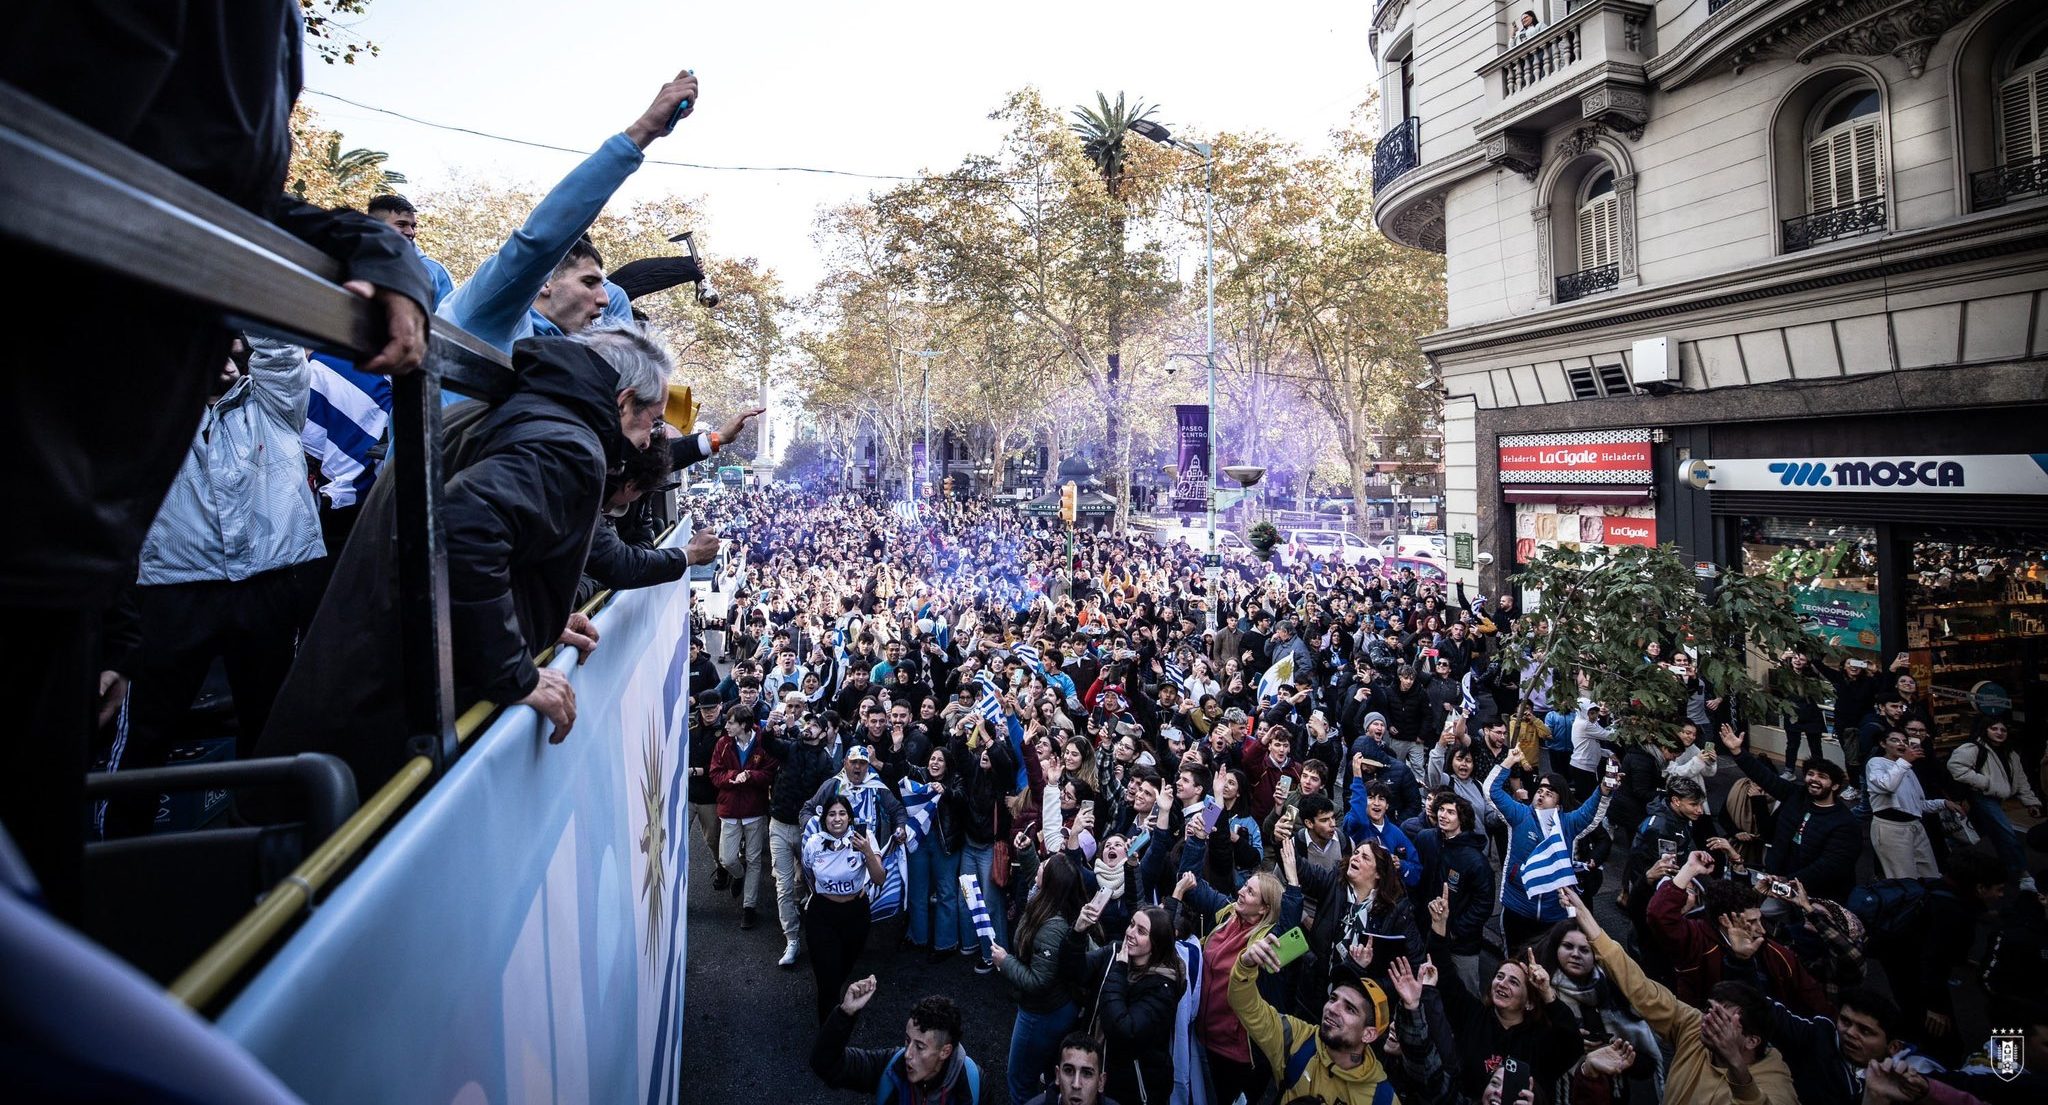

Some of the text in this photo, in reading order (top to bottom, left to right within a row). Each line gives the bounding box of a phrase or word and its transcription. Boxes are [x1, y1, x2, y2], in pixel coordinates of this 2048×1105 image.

[1502, 454, 1537, 463] Heladería
[1601, 452, 1646, 462] Heladería
[1831, 461, 1965, 487] MOSCA
